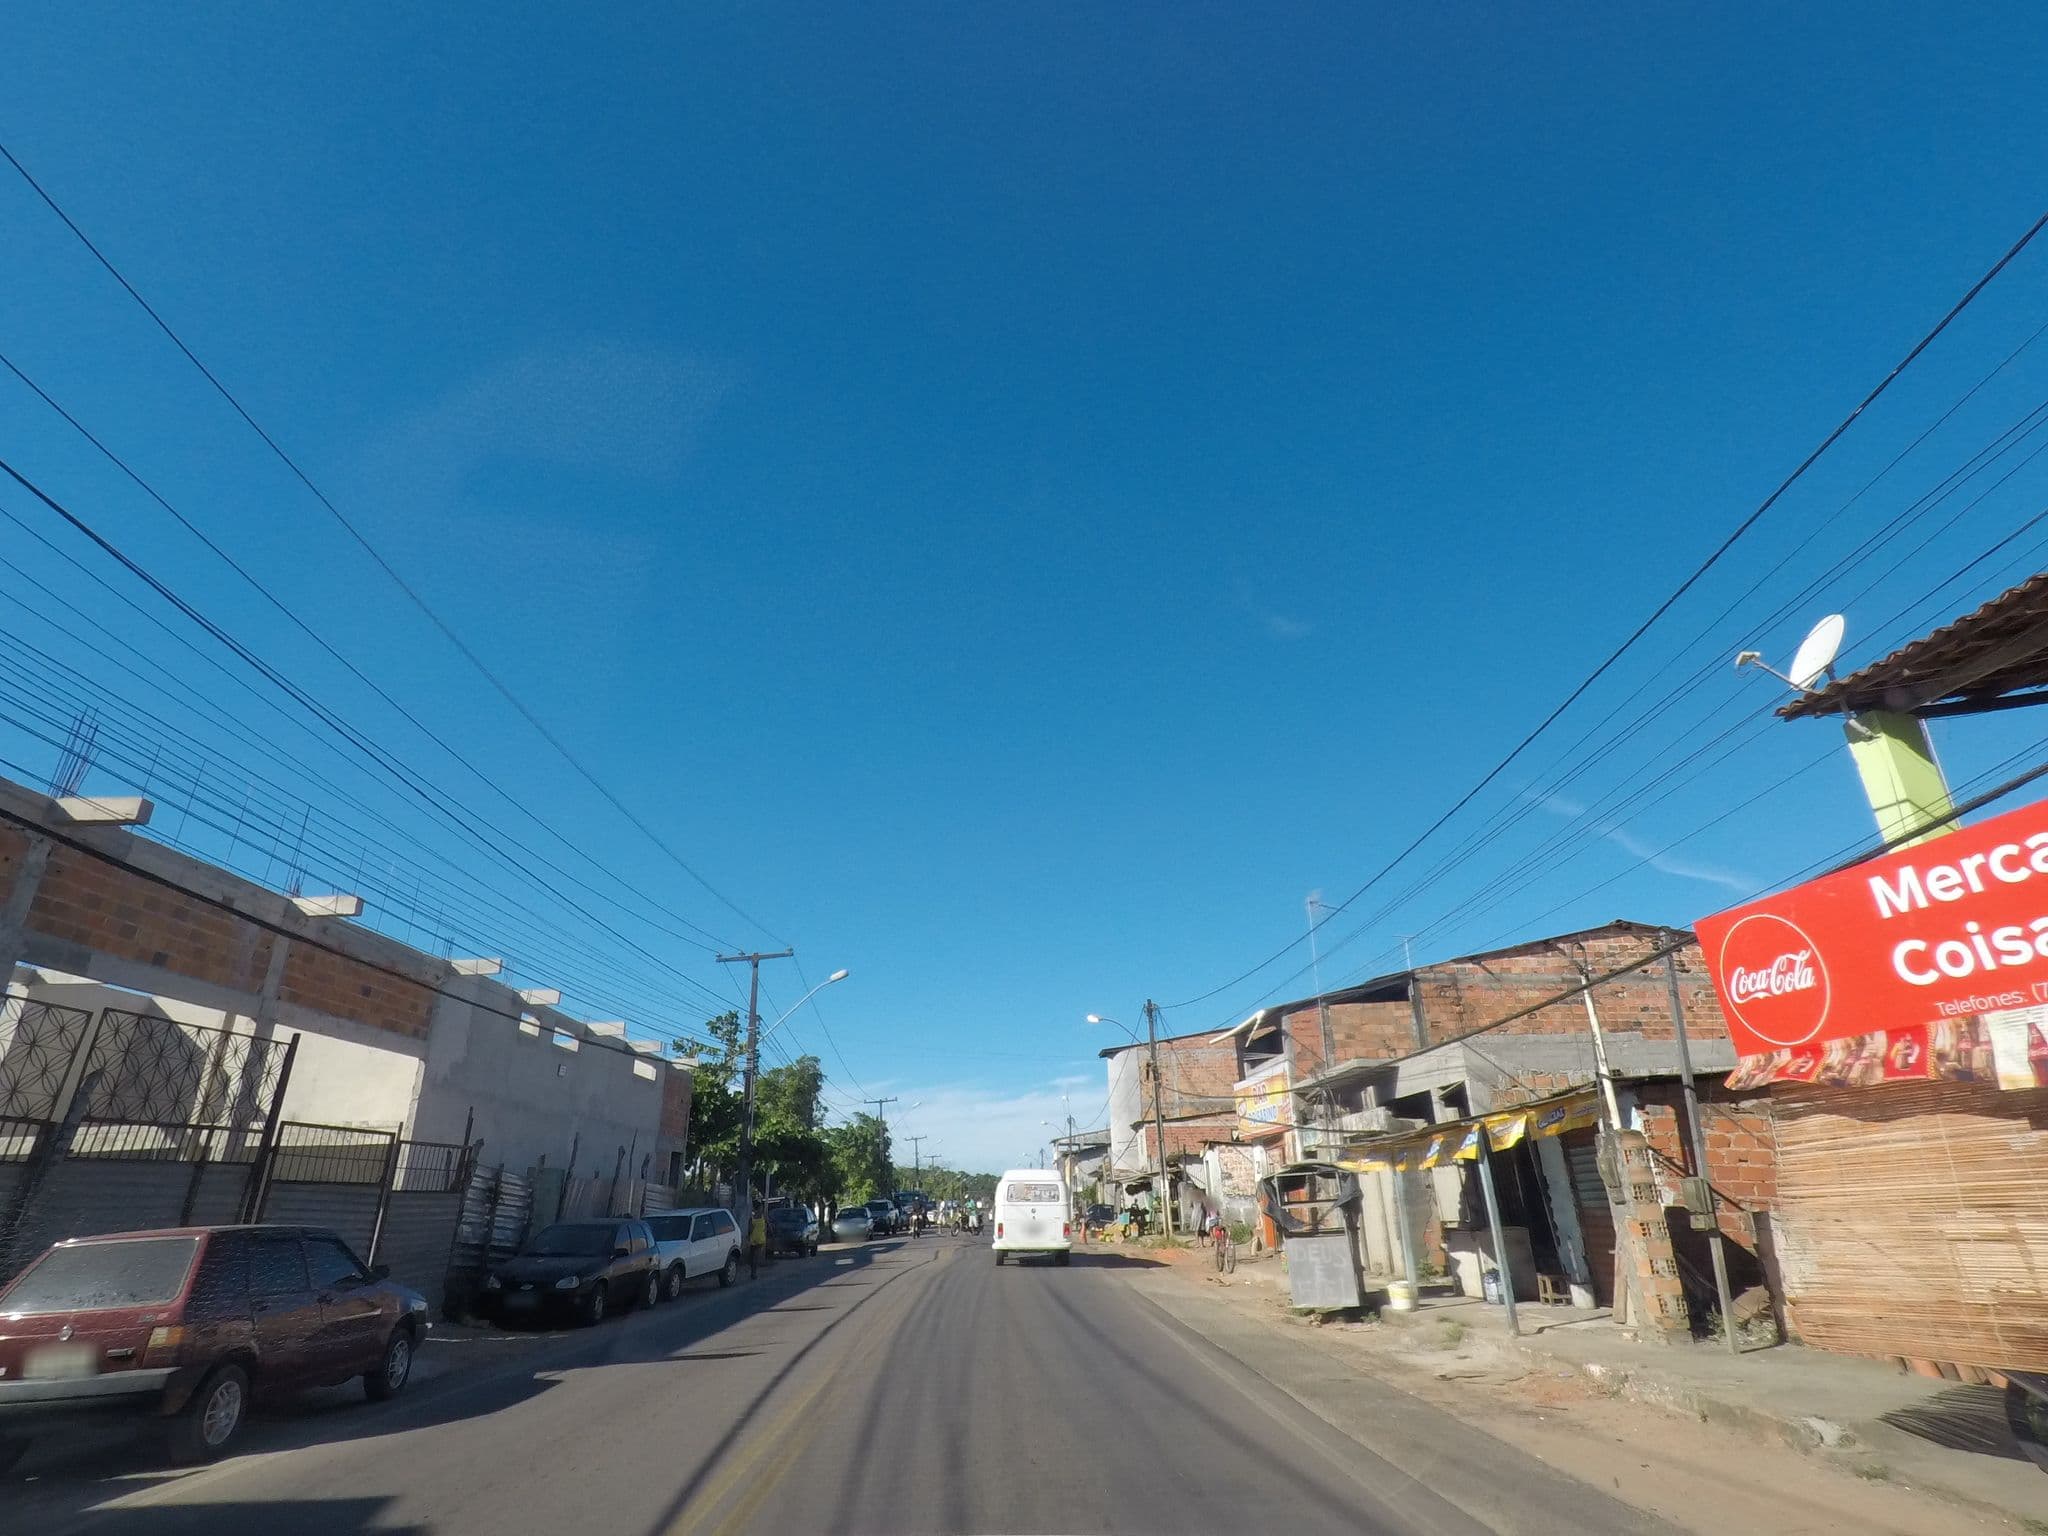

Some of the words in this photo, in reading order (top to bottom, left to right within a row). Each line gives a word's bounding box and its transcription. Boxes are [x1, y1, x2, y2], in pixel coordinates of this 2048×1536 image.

[1868, 831, 2048, 919] Merca
[1731, 949, 1816, 1004] Coca-Cola
[1893, 916, 2048, 986] Coisa
[1935, 991, 2029, 1016] Telefones:
